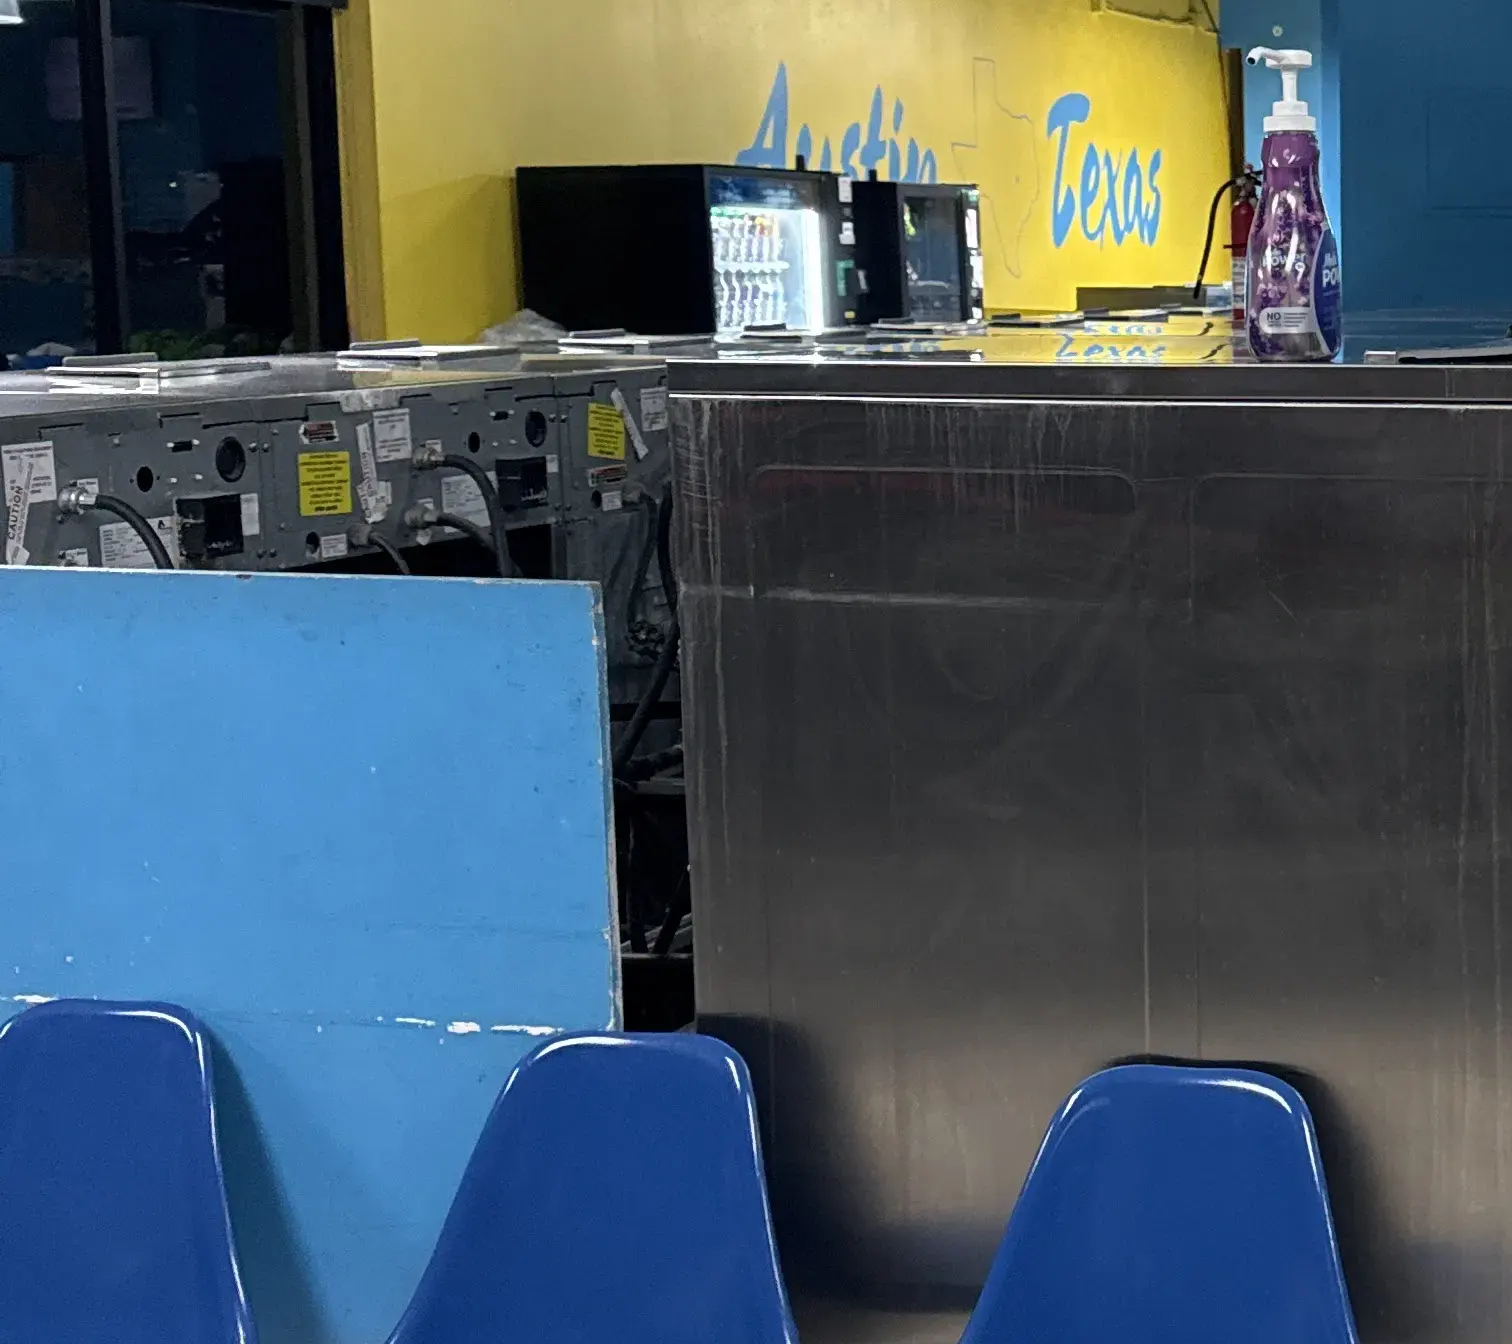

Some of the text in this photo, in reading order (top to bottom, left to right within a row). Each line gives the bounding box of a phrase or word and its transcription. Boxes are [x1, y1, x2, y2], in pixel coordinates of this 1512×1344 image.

[1046, 92, 1162, 251] Texas
[1266, 312, 1281, 321] NO
[8, 485, 23, 540] CAUTION
